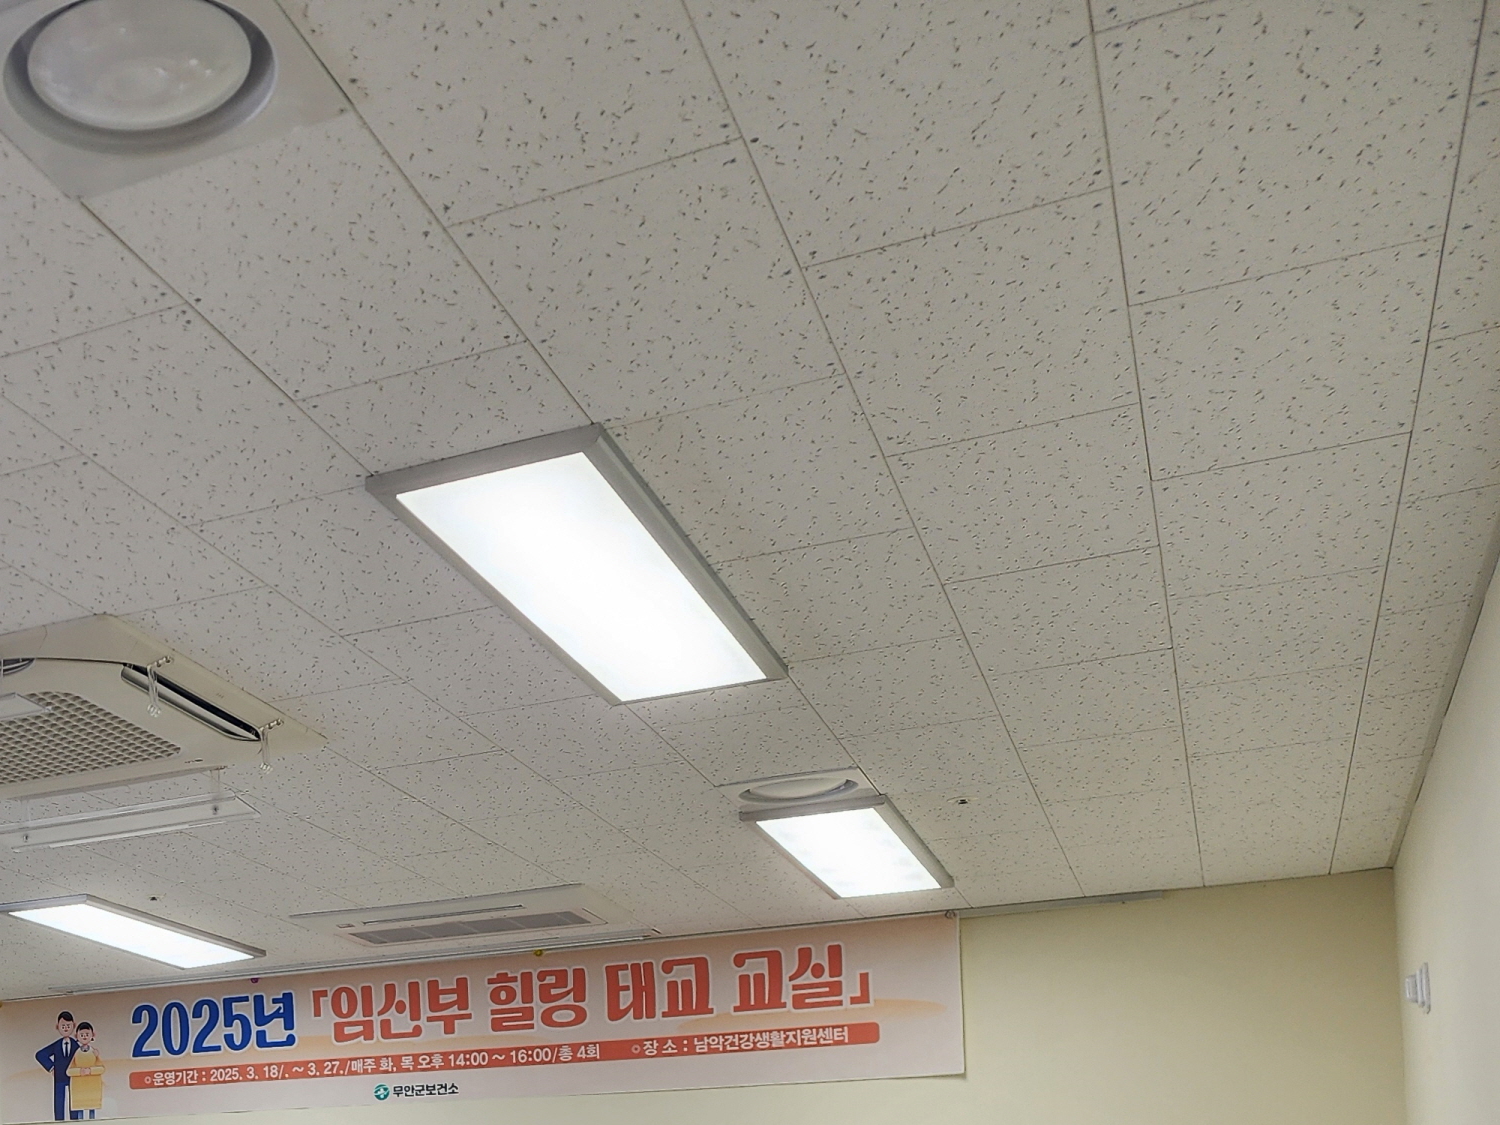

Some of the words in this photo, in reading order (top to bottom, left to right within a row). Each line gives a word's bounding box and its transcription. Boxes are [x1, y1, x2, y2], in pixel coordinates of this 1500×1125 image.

[131, 991, 296, 1058] 2025년
[312, 977, 473, 1043] 「임신부
[487, 967, 588, 1033] 힐링
[605, 956, 714, 1021] 태교
[733, 944, 870, 1013] 교실」
[693, 1026, 849, 1053] 남악건강생활지원센터
[152, 1070, 199, 1086] 운영기간
[210, 1069, 243, 1082] 2025.
[246, 1067, 259, 1080] 3.
[307, 1063, 320, 1076] 3.
[379, 1057, 397, 1072] 화,
[401, 1056, 414, 1071] 목
[417, 1053, 445, 1069] 오후
[448, 1051, 489, 1067] 14:00
[576, 1043, 600, 1060] 4회
[392, 1082, 459, 1098] 무안군보건소
